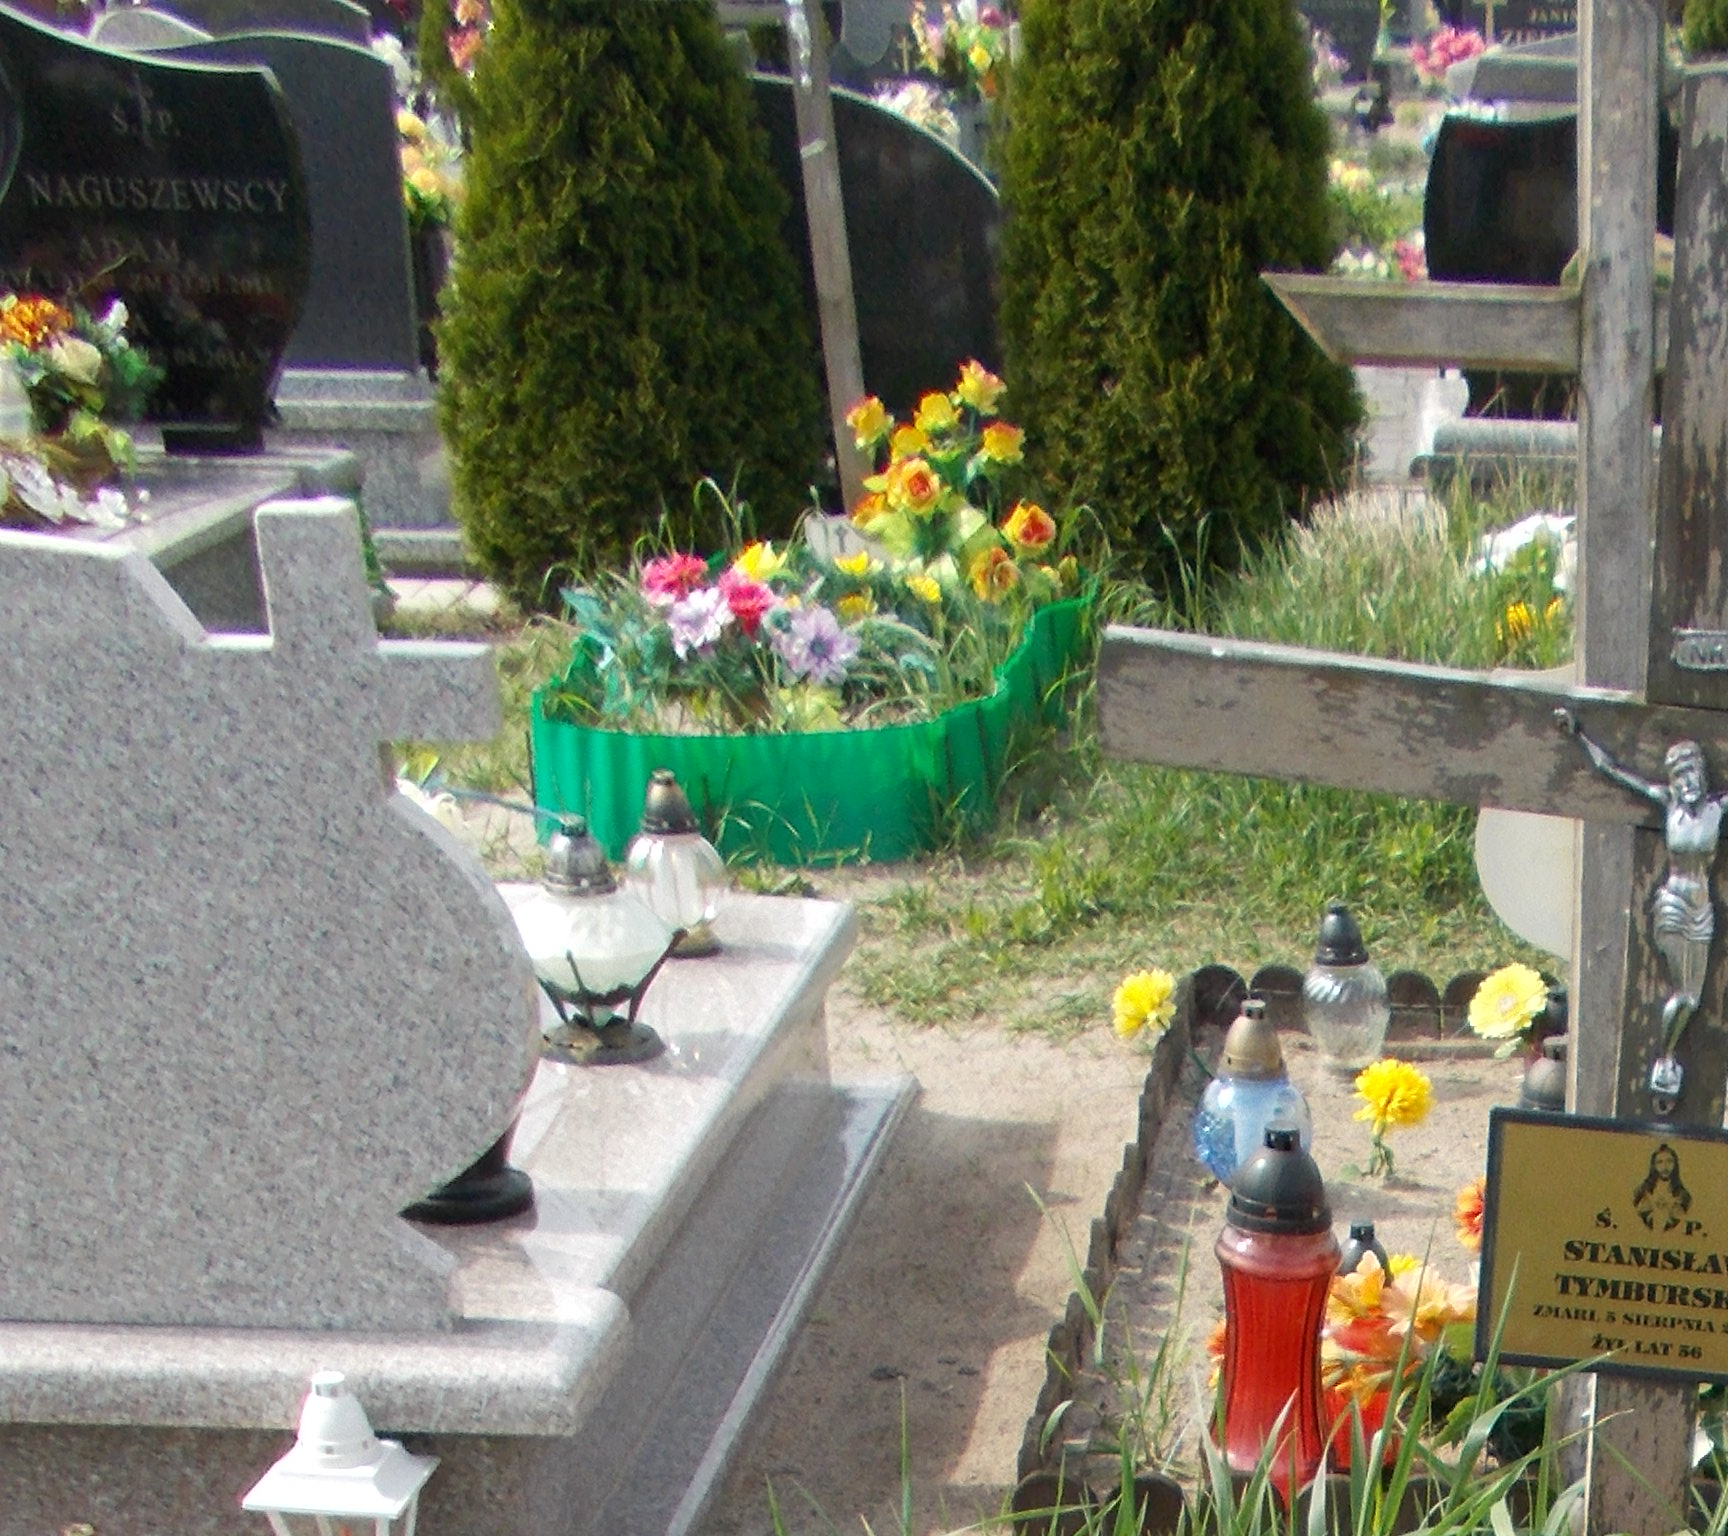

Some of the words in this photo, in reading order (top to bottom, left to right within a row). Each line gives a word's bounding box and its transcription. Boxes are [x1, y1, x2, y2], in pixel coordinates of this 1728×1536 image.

[27, 173, 287, 211] NAGUSZEWSCY
[1605, 1311, 1616, 1323] 5
[1622, 1312, 1716, 1333] SIERPNIA
[1634, 1340, 1673, 1357] LAT
[1678, 1344, 1702, 1359] 56
